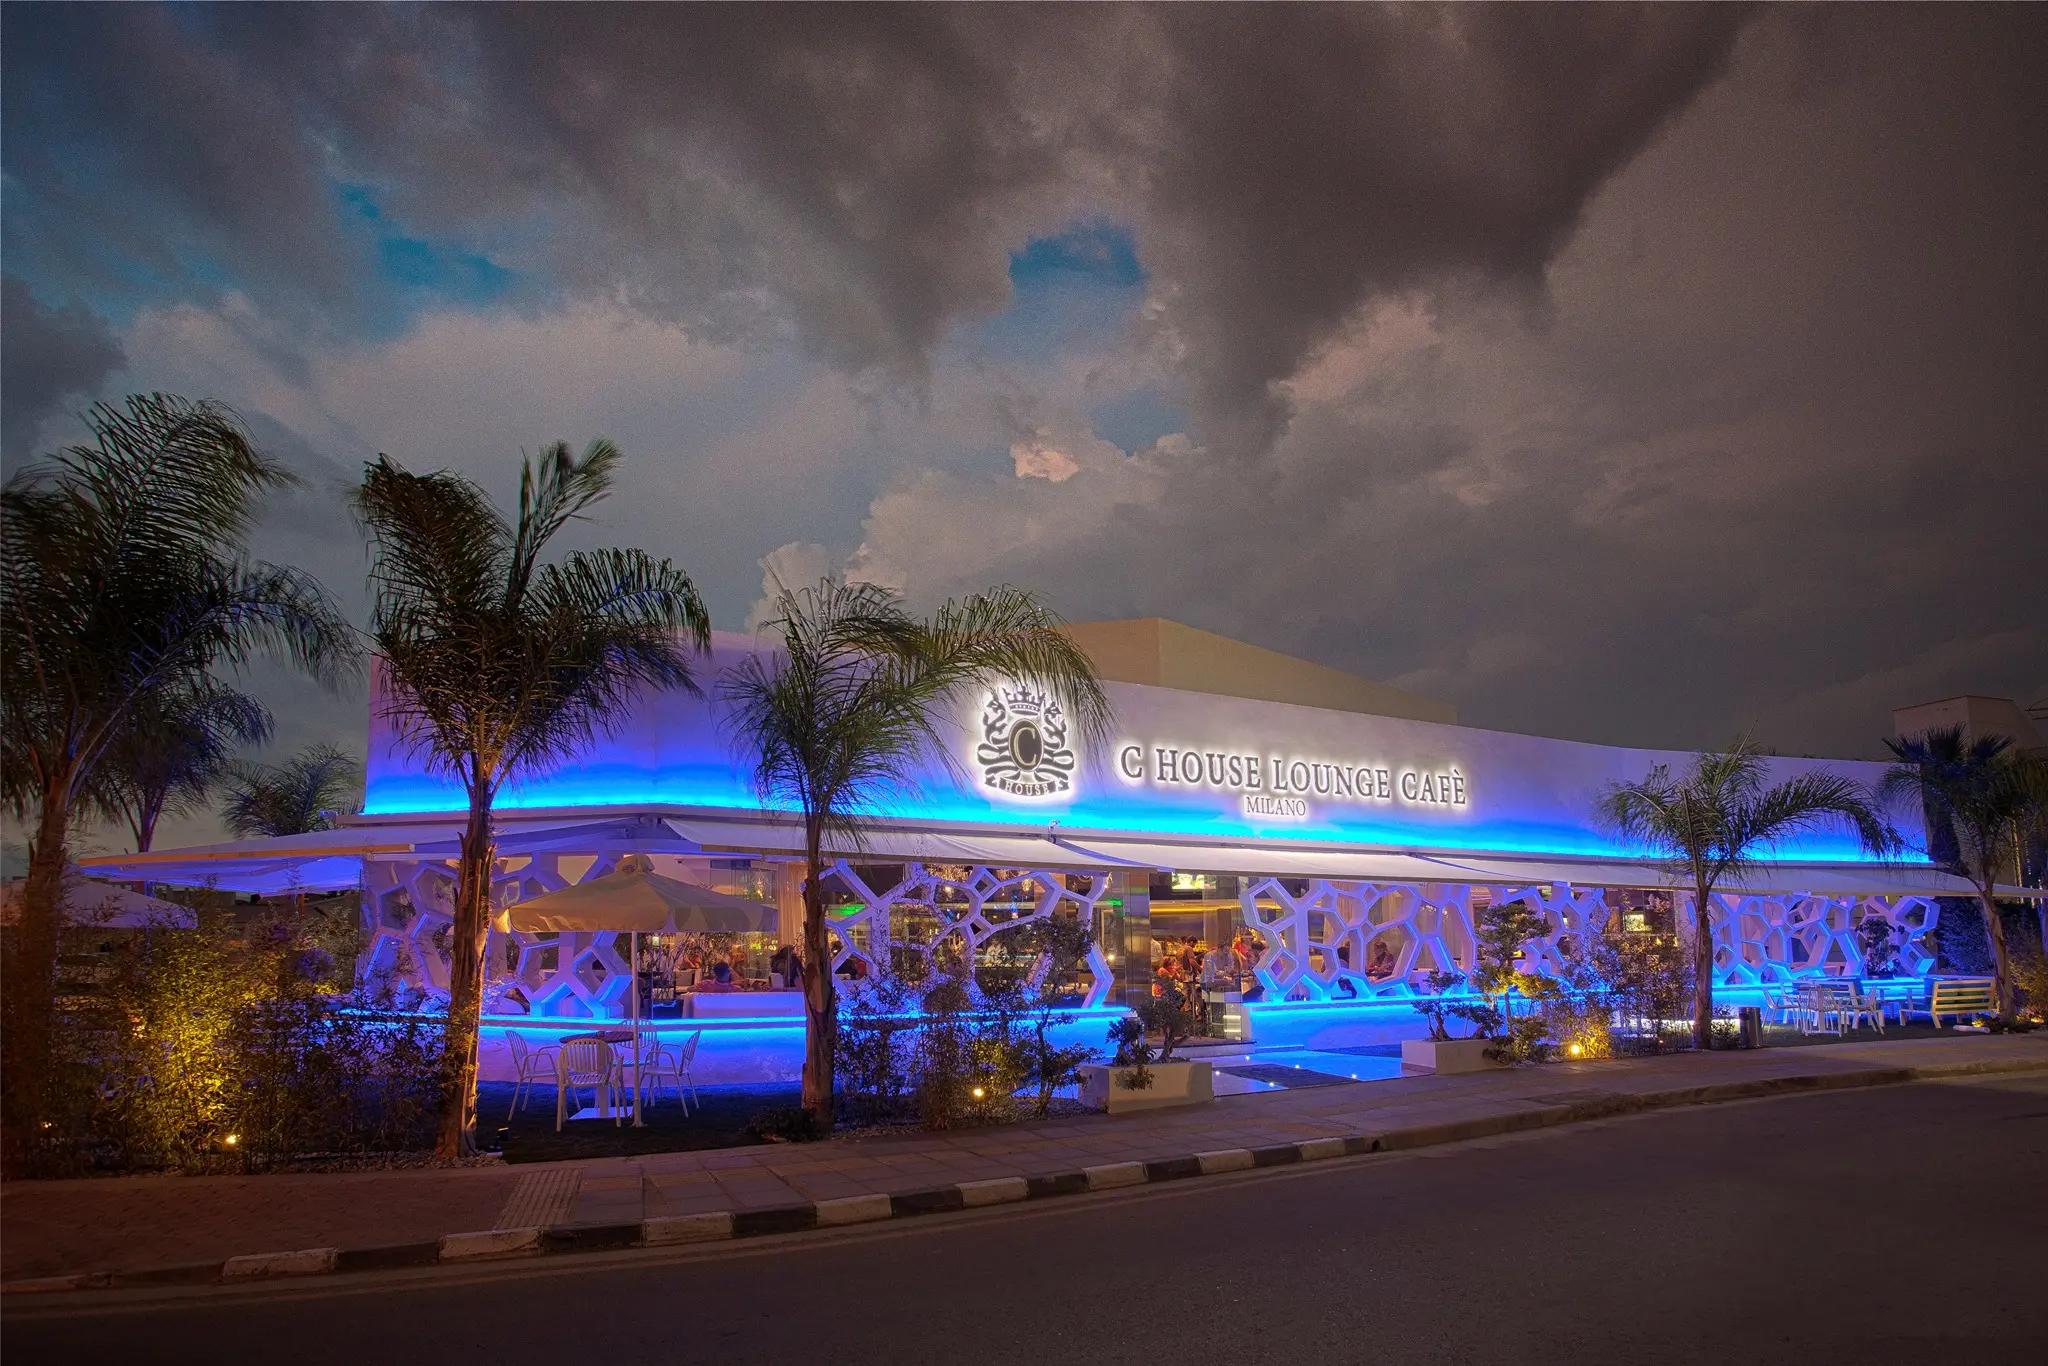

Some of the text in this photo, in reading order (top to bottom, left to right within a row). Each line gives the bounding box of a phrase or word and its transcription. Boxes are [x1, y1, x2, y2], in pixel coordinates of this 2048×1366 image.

[1013, 727, 1037, 766] C
[1005, 781, 1049, 796] HOUSE
[1120, 745, 1466, 805] C HOUSE LOUNGE CAFÈ
[1246, 796, 1306, 817] MILANO
